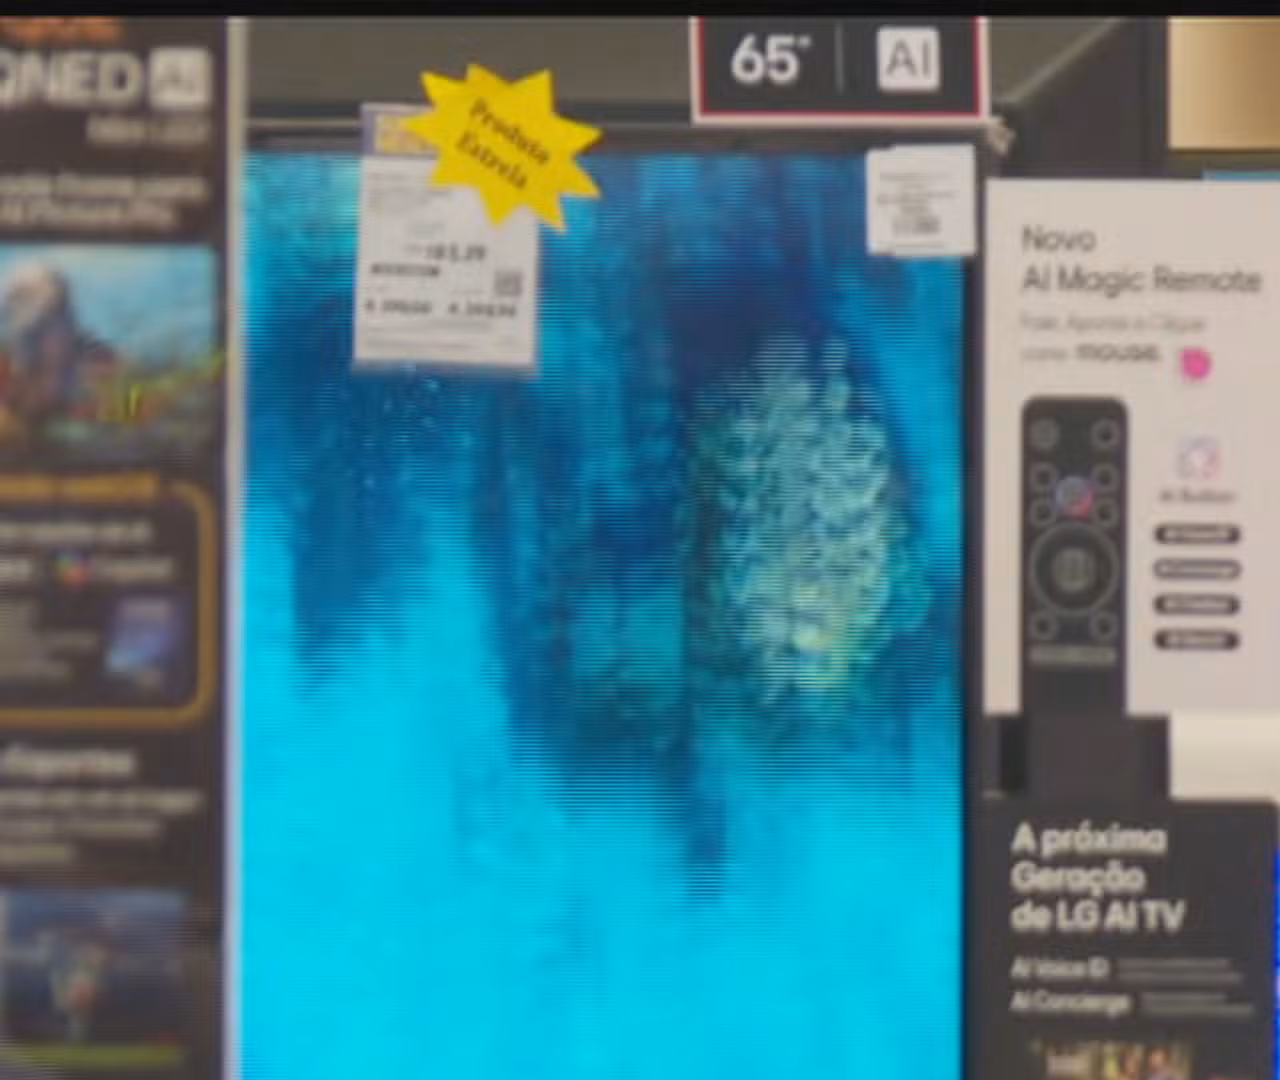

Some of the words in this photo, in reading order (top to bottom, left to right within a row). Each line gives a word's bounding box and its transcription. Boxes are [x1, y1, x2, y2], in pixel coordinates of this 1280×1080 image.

[886, 38, 931, 78] AI
[467, 96, 551, 166] Produto
[453, 130, 529, 190] Estrela
[1022, 225, 1097, 253] Novo
[1023, 265, 1047, 290] AI
[1057, 265, 1144, 299] Magic
[1153, 265, 1263, 293] Remote
[1011, 822, 1036, 852] A
[1040, 820, 1167, 858] próxima
[1010, 860, 1145, 896] Geração
[1010, 900, 1050, 931] de
[1056, 901, 1099, 931] LG
[1105, 901, 1137, 931] AI
[1142, 900, 1185, 931] TV
